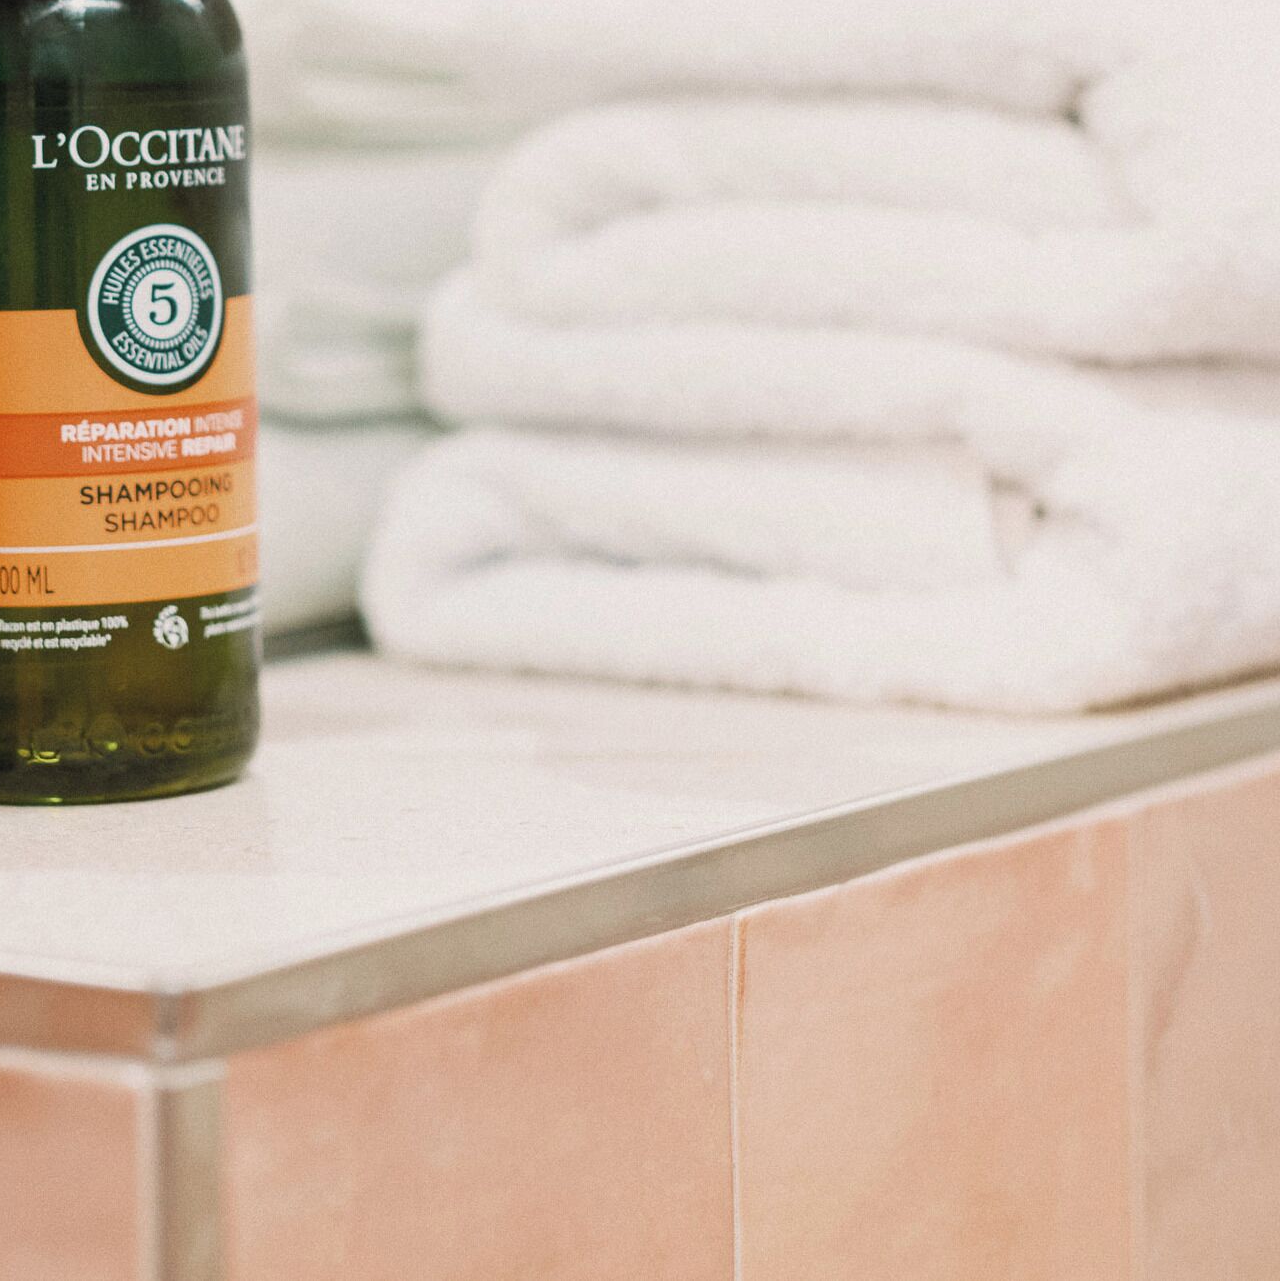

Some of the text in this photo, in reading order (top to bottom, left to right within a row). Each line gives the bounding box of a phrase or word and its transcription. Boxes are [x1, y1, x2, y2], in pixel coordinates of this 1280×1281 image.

[31, 124, 247, 169] L'OCCITANE
[85, 167, 226, 192] EN PROVENCE
[101, 237, 215, 306] HUILES ESSENTIELLES
[148, 281, 177, 327] 5
[111, 324, 208, 371] ESSENTIAL OILS
[60, 417, 191, 444] RÉPARATION
[82, 433, 238, 464] INTENSIVE REPAIR
[79, 472, 233, 506] SHAMPOOING
[104, 503, 220, 534] SHAMPOO
[26, 565, 56, 595] ML
